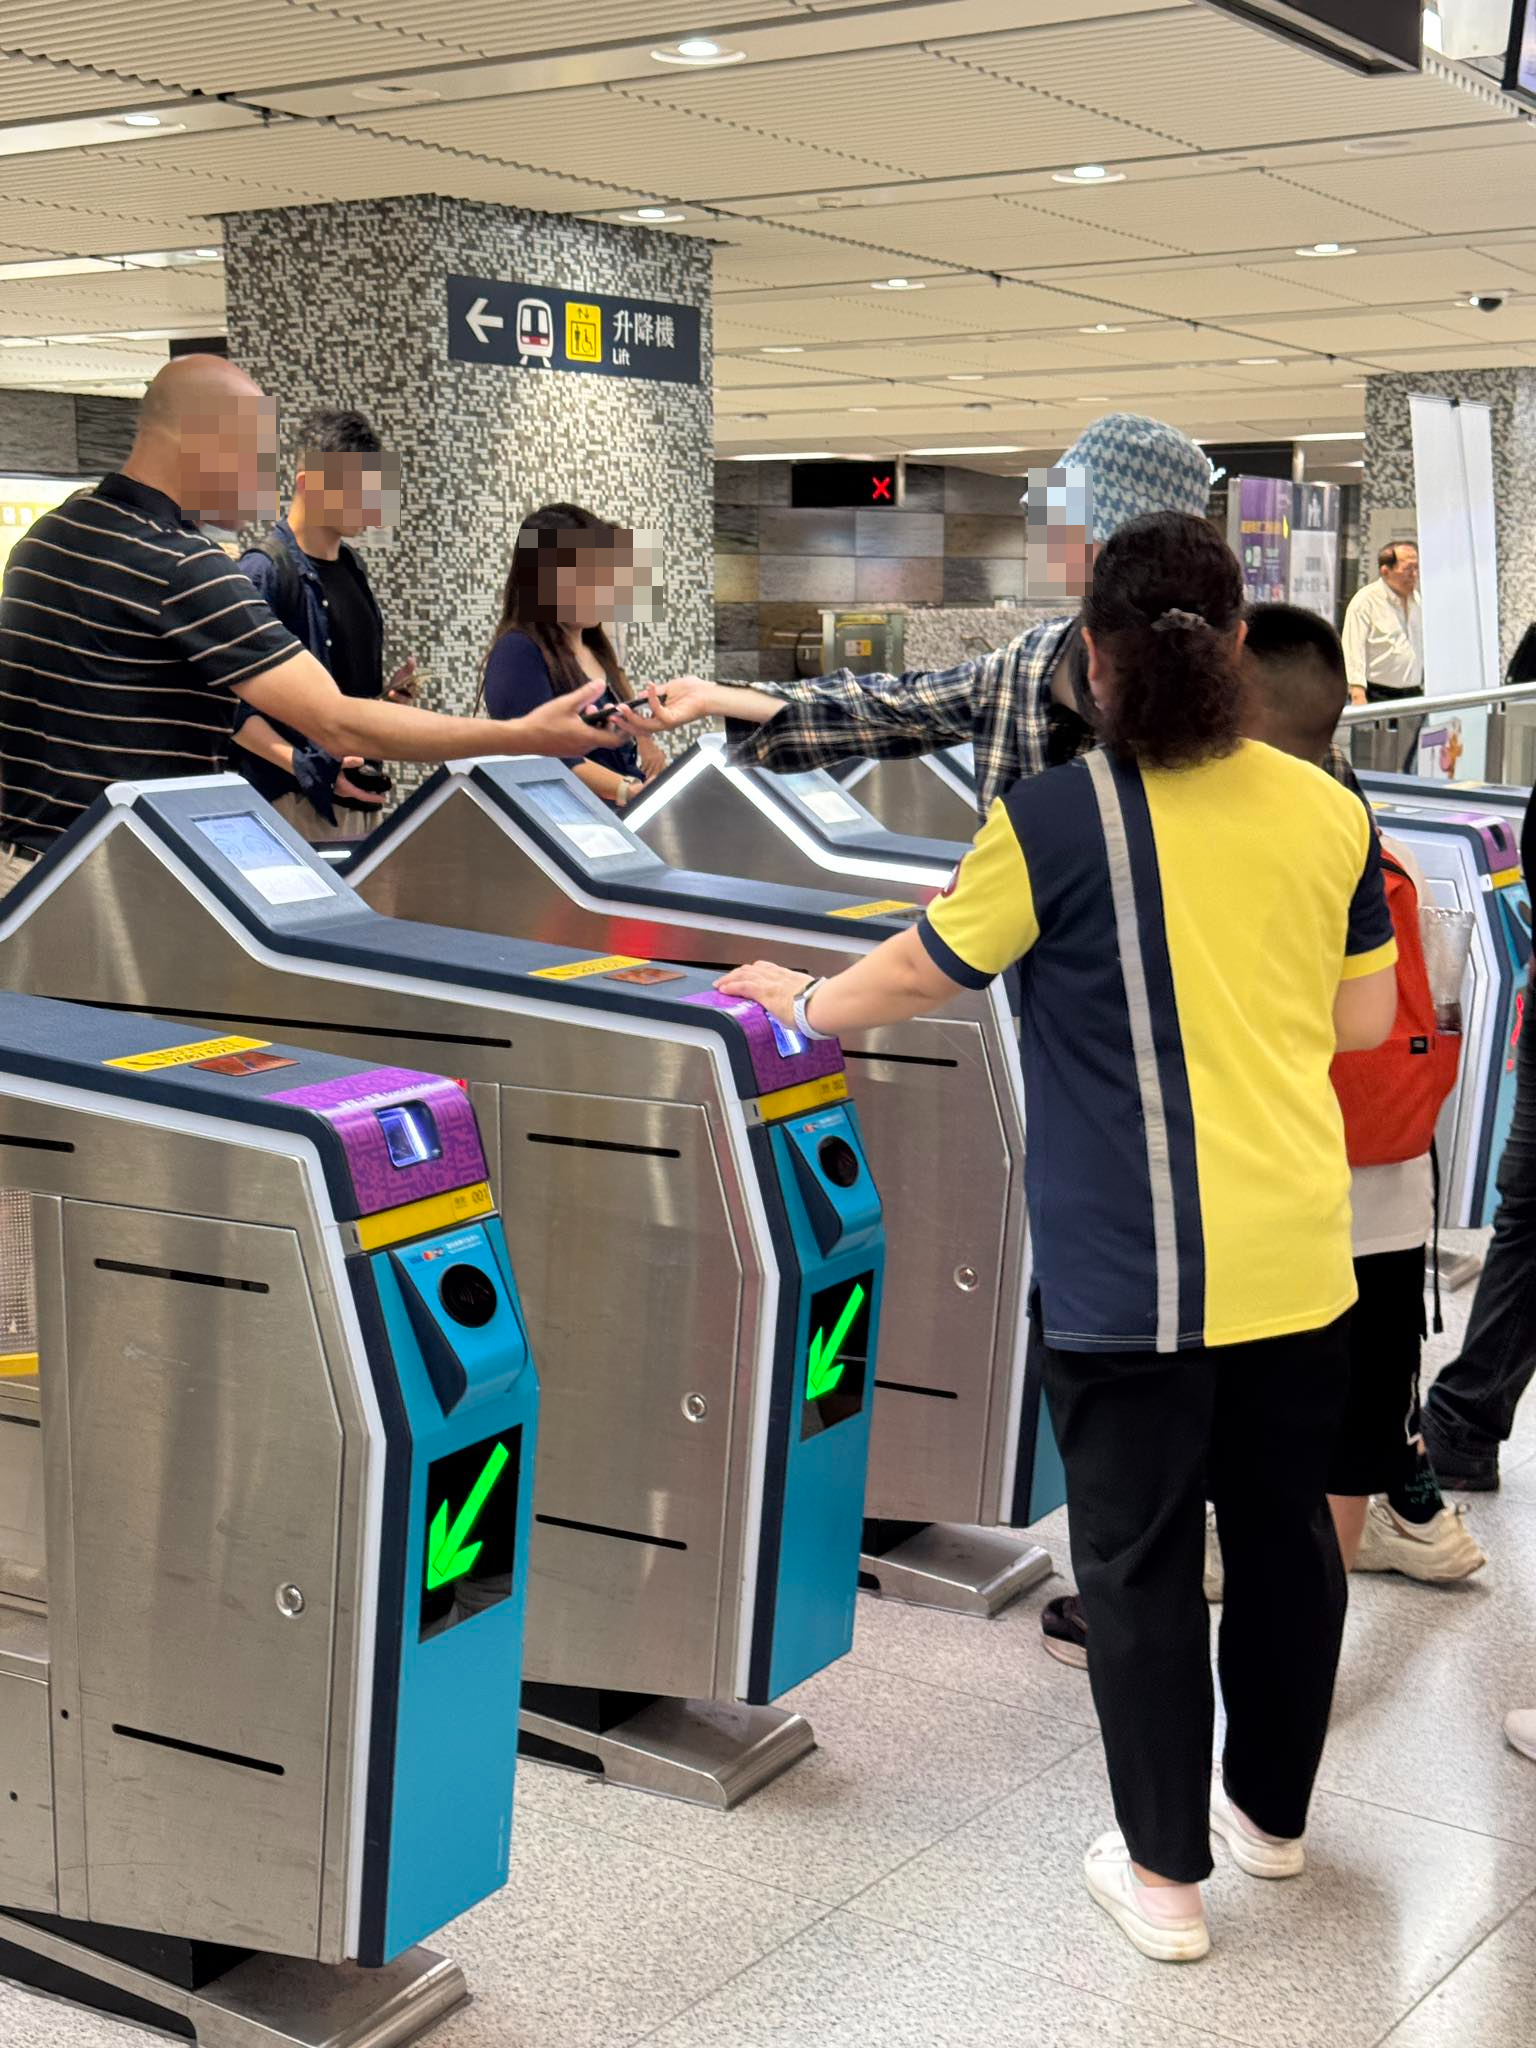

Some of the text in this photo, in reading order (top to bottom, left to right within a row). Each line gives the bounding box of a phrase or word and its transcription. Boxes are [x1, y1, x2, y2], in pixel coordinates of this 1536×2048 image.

[612, 309, 675, 348] 升降機
[612, 347, 631, 366] Lift
